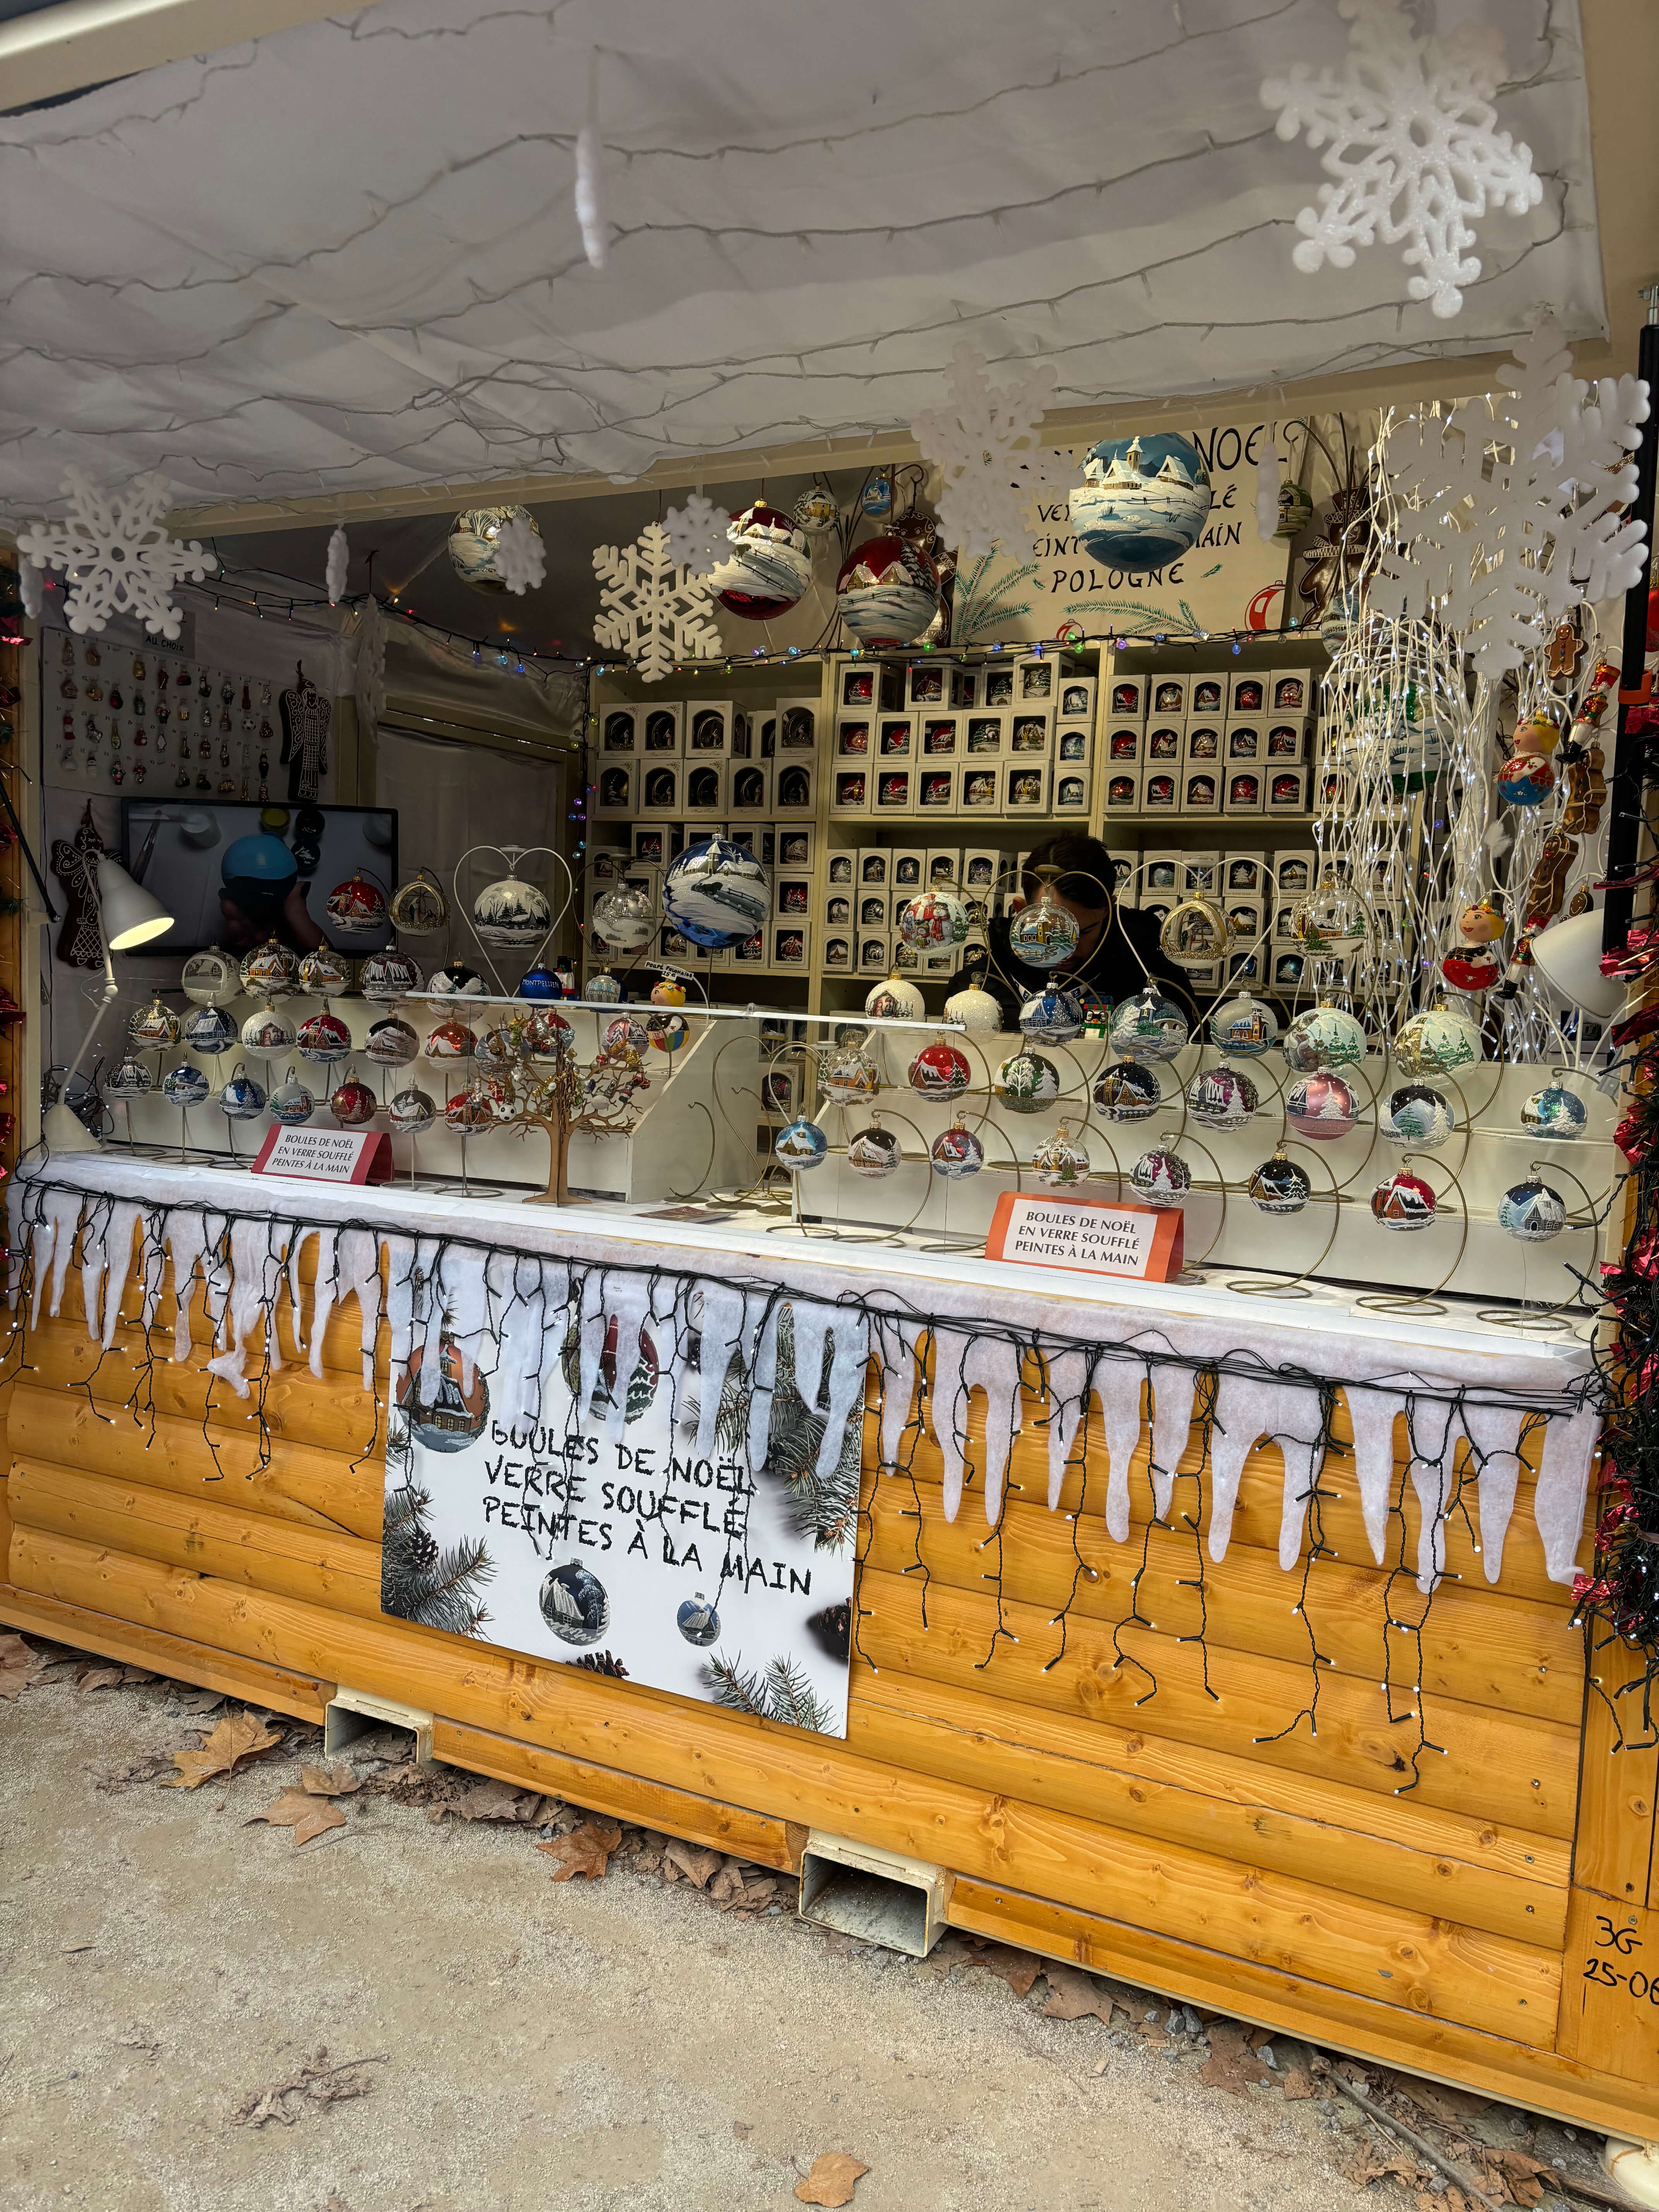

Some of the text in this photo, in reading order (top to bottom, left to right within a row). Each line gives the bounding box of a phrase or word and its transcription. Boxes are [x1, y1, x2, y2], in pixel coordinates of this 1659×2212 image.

[1051, 563, 1184, 593] POLOGNE
[522, 979, 559, 988] MONTPELLIER
[278, 1146, 354, 1161] EN VERRE SOUFFLÉ
[285, 1135, 354, 1149] BOULES DE NOËL
[271, 1158, 350, 1173] PEINTES À LA MAIN
[1026, 1211, 1136, 1234] BOULES DE NOËL
[1019, 1225, 1140, 1250] EN VERRE SOUFFLÉ
[1015, 1240, 1139, 1266] PEINTES À LA MAIN
[492, 1420, 754, 1497] BOULES DE NOËL
[484, 1454, 746, 1535] VERRE SOUFFLÉ
[483, 1496, 812, 1596] PEINTES À LA MAIN
[1595, 1915, 1643, 1954] 3G
